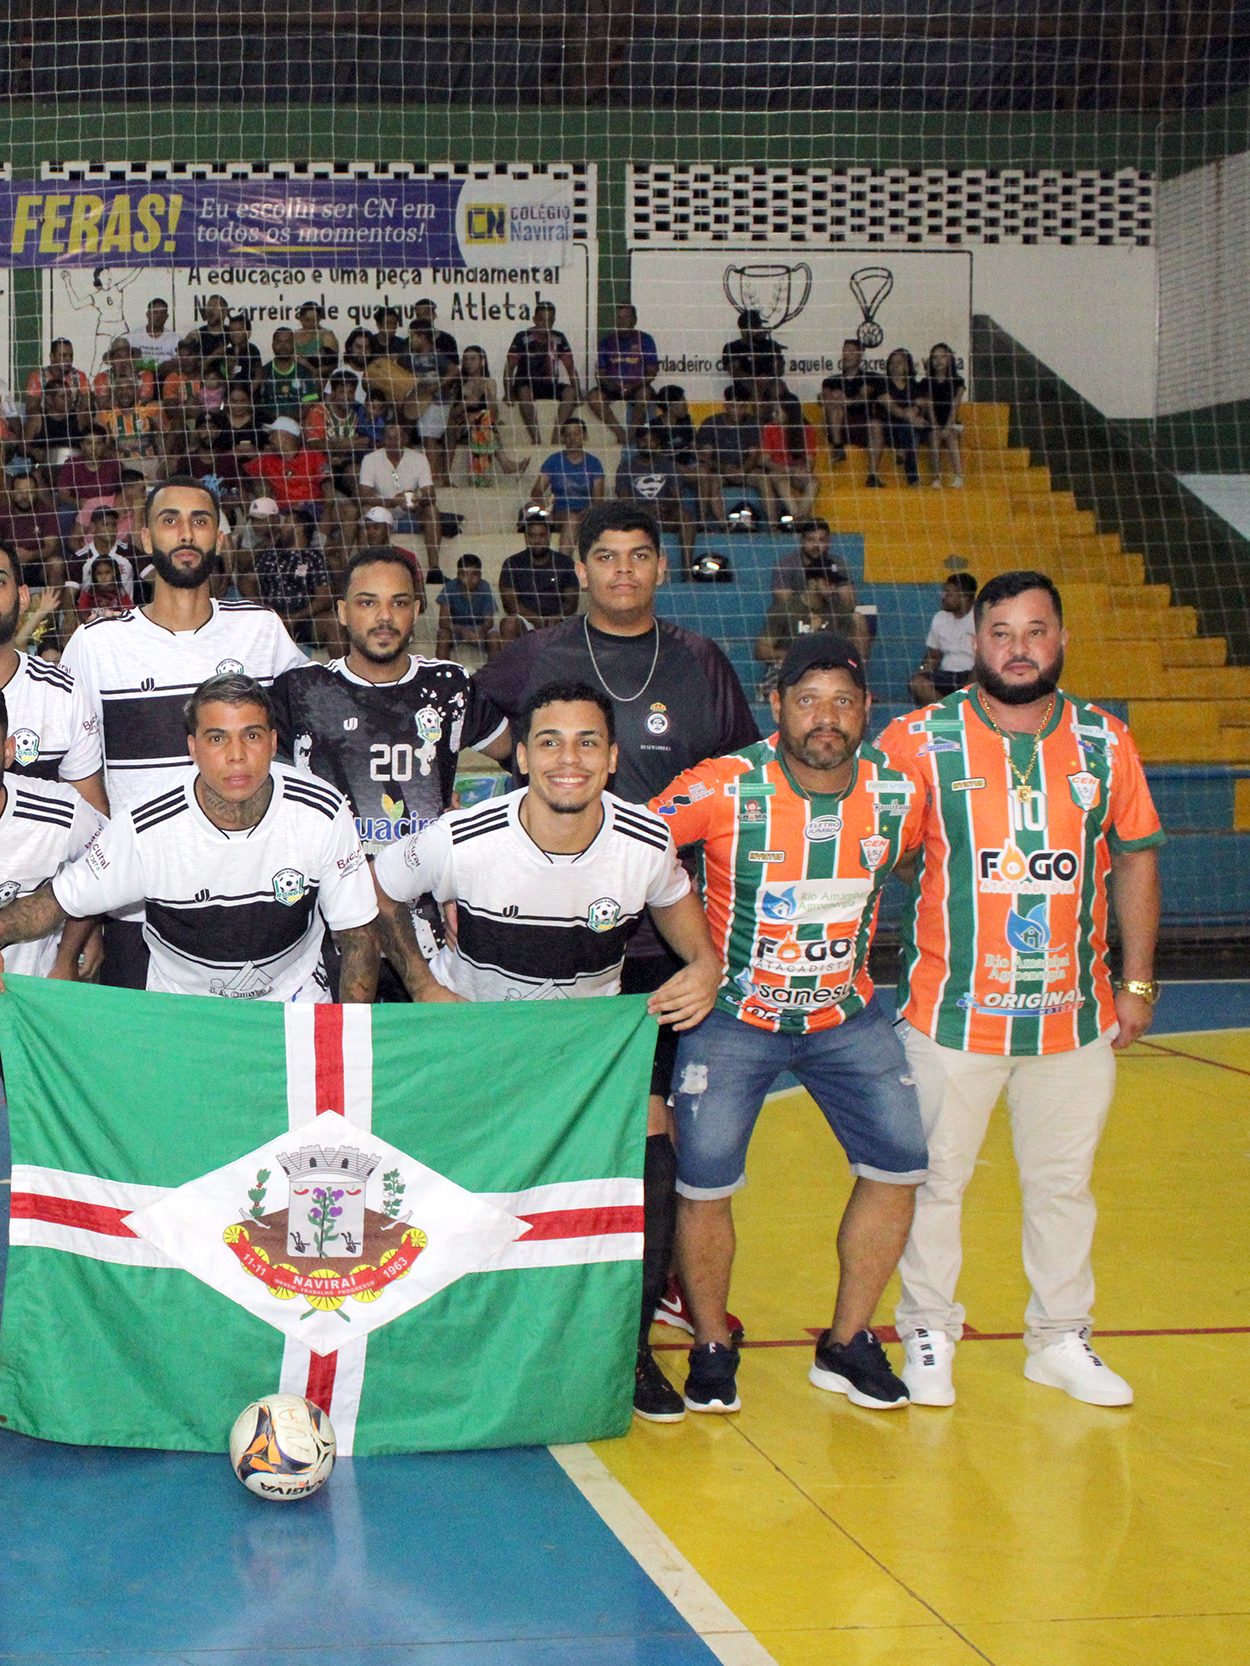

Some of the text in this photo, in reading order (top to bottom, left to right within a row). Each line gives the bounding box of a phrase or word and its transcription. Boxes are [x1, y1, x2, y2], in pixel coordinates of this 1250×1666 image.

[200, 197, 436, 218] Eu escolhi ser CN em
[510, 204, 570, 221] COLÉGIO
[10, 193, 183, 254] FERAS!
[197, 221, 426, 243] todos os momentos!
[188, 267, 201, 286] A
[329, 267, 369, 284] uma
[376, 267, 422, 290] peça
[106, 296, 114, 306] 6
[656, 354, 712, 372] rdadeiro
[789, 356, 834, 374] aquele
[370, 743, 413, 782] 20
[1071, 776, 1098, 786] CEN
[1010, 790, 1048, 831] 10
[355, 811, 440, 841] uacir
[809, 821, 840, 829] ELETRO
[92, 843, 111, 870] cural
[981, 842, 1077, 882] FOGO
[981, 880, 1074, 892] ATACADISTA
[797, 900, 856, 912] Agroenergia
[801, 892, 817, 901] Rio
[756, 931, 852, 963] FOGO
[755, 959, 851, 973] ATACADISTA
[985, 954, 1010, 968] Rio
[983, 988, 1086, 1008] ORIGINAL
[242, 1253, 267, 1277] 11-11
[382, 1256, 408, 1280] 1963
[274, 1278, 376, 1296] ORDEM TRABALHO PROGRESSO
